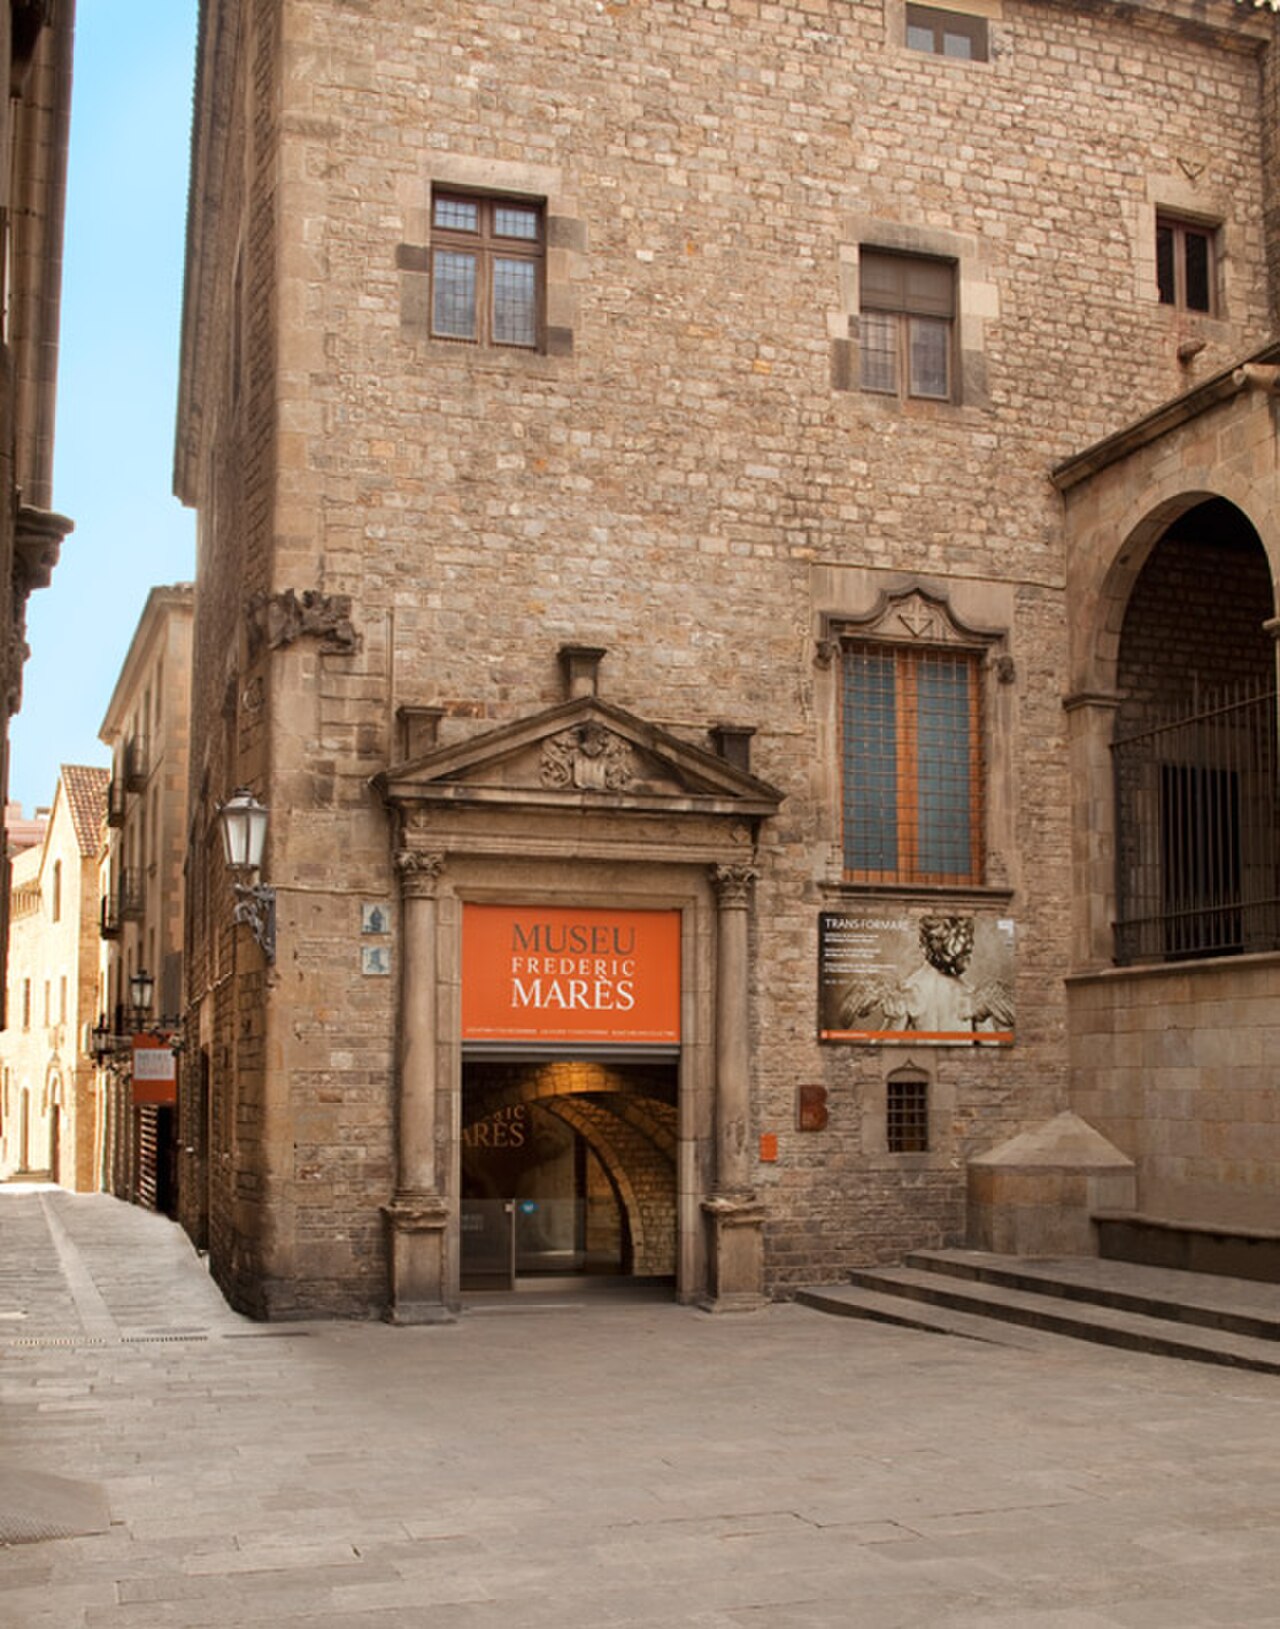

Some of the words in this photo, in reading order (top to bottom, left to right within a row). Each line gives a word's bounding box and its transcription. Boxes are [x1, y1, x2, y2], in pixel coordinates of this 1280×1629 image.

[511, 923, 636, 956] MUSEU
[511, 956, 636, 977] FREDERIC
[510, 975, 636, 1011] MARÈS
